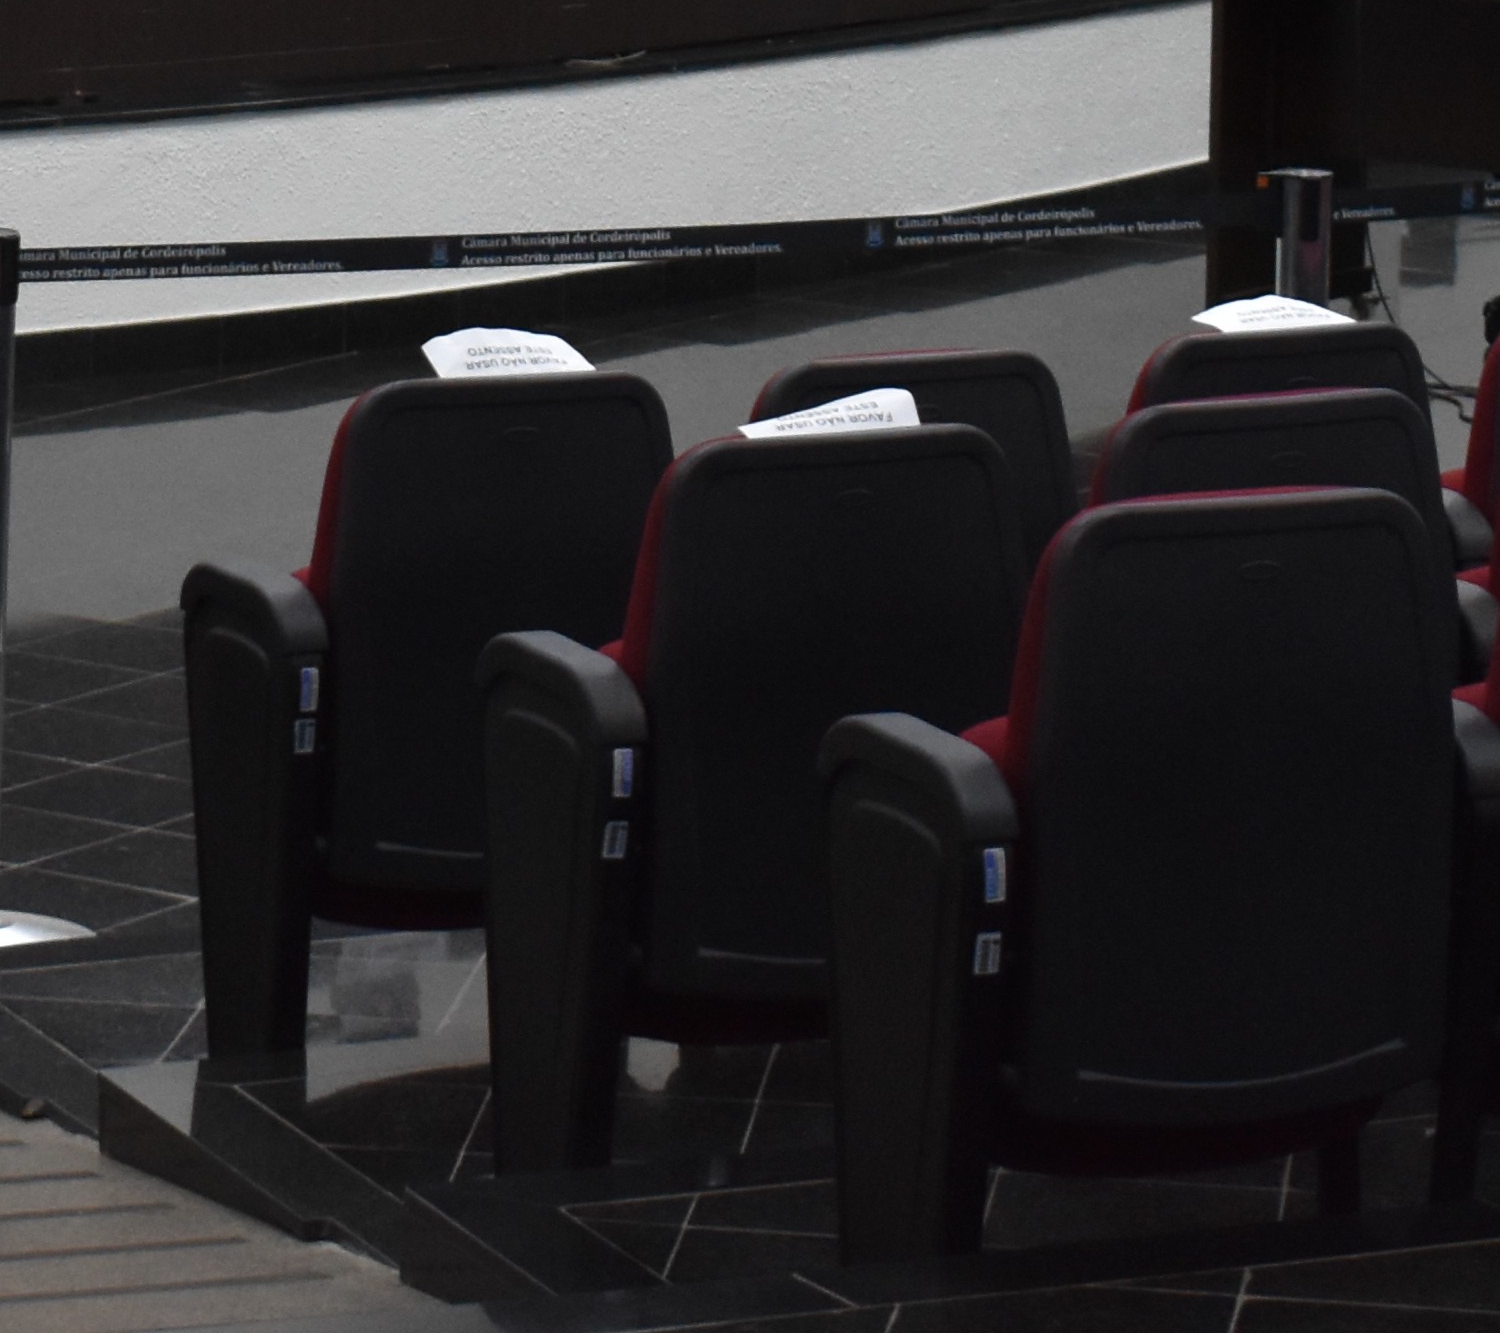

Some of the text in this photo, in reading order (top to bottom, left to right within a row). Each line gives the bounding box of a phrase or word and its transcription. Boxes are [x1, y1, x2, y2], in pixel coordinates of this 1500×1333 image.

[894, 207, 1096, 229] Câmara Municipal de Cordeirópolis
[461, 229, 672, 249] Câmara Municipal de Cordeirópolis
[894, 234, 934, 247] Acesso
[937, 232, 981, 245] restrito
[982, 231, 1023, 245] apenas
[1025, 228, 1052, 242] para
[1054, 222, 1126, 239] funcionários
[1127, 224, 1135, 233] e
[19, 244, 227, 263] mara Municipal de Cordeirópolis
[460, 253, 502, 266] Acesso
[505, 251, 550, 265] restrito
[553, 251, 596, 266] apenas
[598, 250, 625, 264] para
[628, 245, 703, 261] funcionários
[705, 247, 713, 257] e
[19, 269, 50, 280] cesso
[53, 266, 100, 279] restrito
[102, 266, 148, 281] apenas
[150, 265, 179, 279] para
[181, 260, 260, 276] funcionários
[262, 262, 270, 273] e
[467, 345, 552, 357] ESTE ASSENTO
[466, 356, 568, 370] FAVOR NÃO USAR
[776, 401, 879, 421] ESTE ASSENTO
[776, 412, 894, 432] FAVOR NÃO USAR
